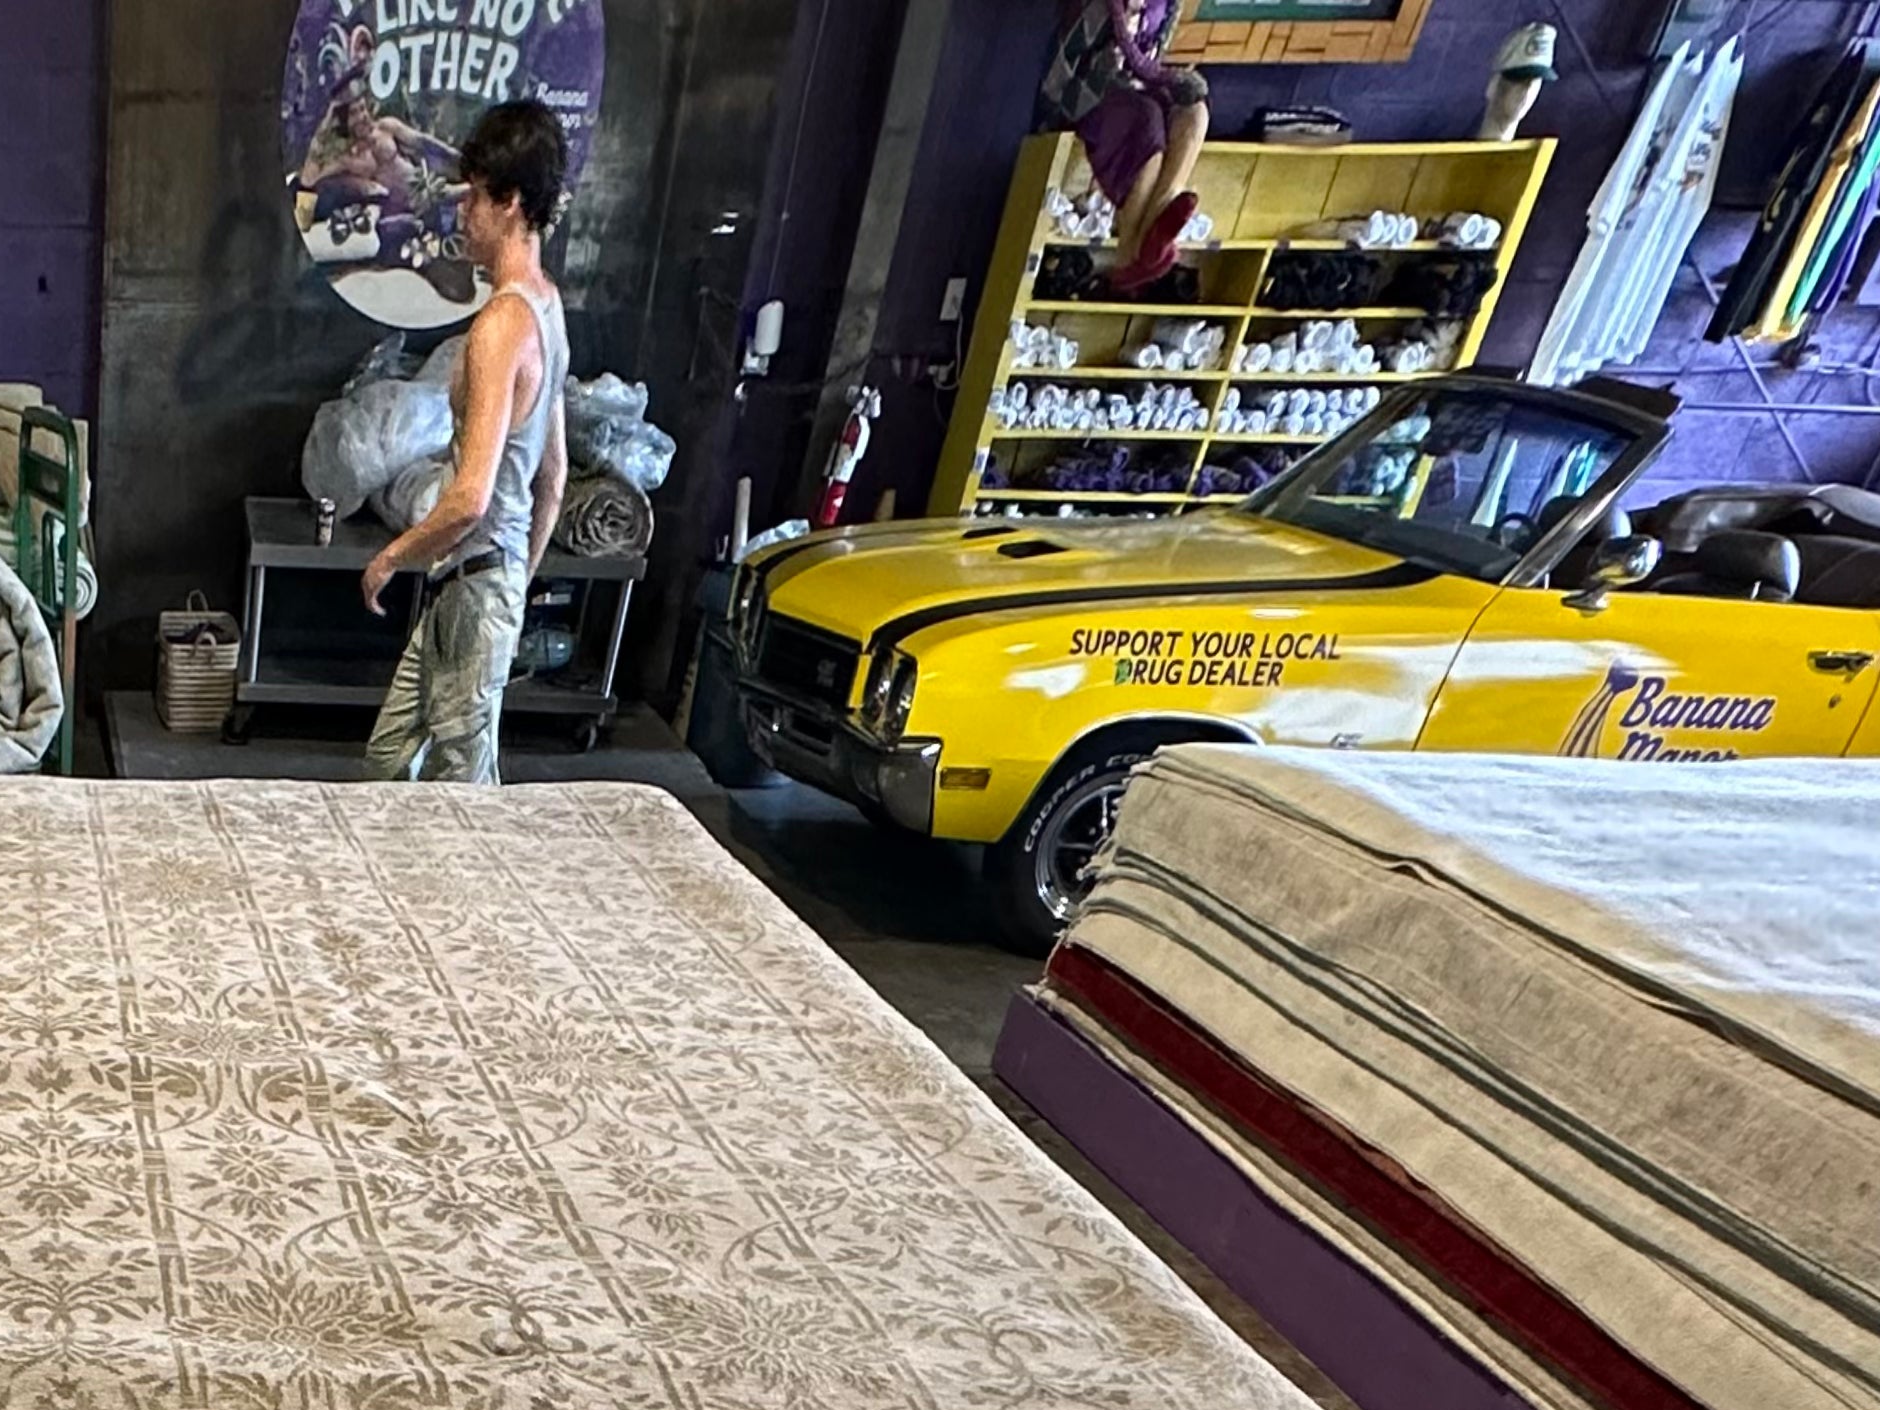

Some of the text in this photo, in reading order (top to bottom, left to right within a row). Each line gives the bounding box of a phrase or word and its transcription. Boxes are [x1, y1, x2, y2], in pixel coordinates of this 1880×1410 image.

[370, 31, 520, 103] OTHER
[1069, 629, 1342, 661] SUPPORT YOUR LOCAL
[1186, 660, 1284, 687] DEALER
[1618, 676, 1776, 731] Banana
[1024, 764, 1096, 852] COOPER
